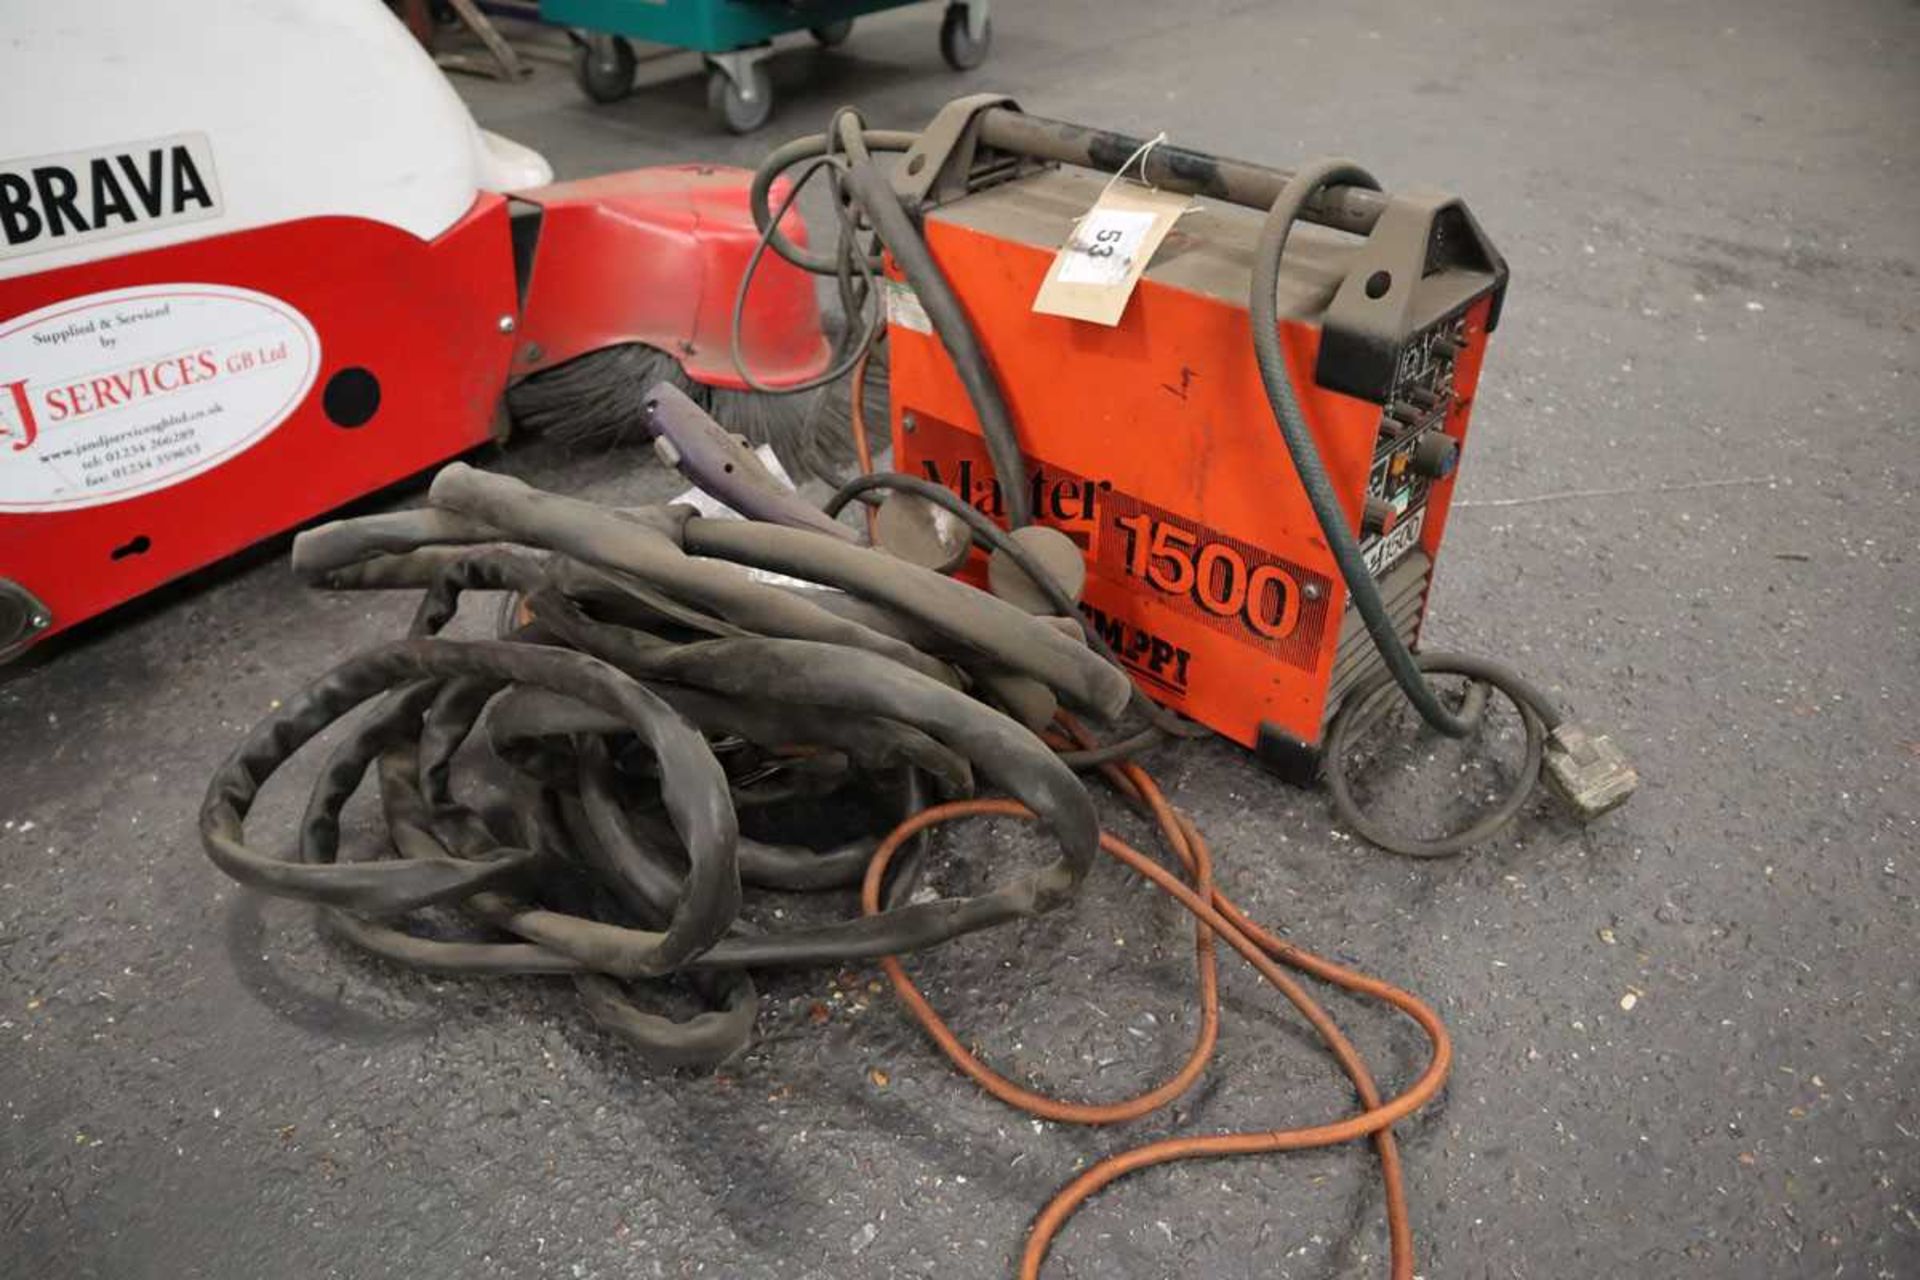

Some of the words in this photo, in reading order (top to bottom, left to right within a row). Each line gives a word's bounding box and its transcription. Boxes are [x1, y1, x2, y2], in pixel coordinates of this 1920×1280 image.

[0, 145, 214, 245] BRAVA
[1088, 228, 1122, 258] 53
[32, 319, 95, 346] Supplied
[99, 320, 112, 332] &
[115, 303, 171, 326] Serviced
[99, 335, 117, 348] by
[45, 349, 219, 421] SERVICES
[226, 354, 255, 375] GB
[258, 341, 288, 366] Ltd
[922, 460, 1112, 520] Mater
[1115, 513, 1301, 640] 1500
